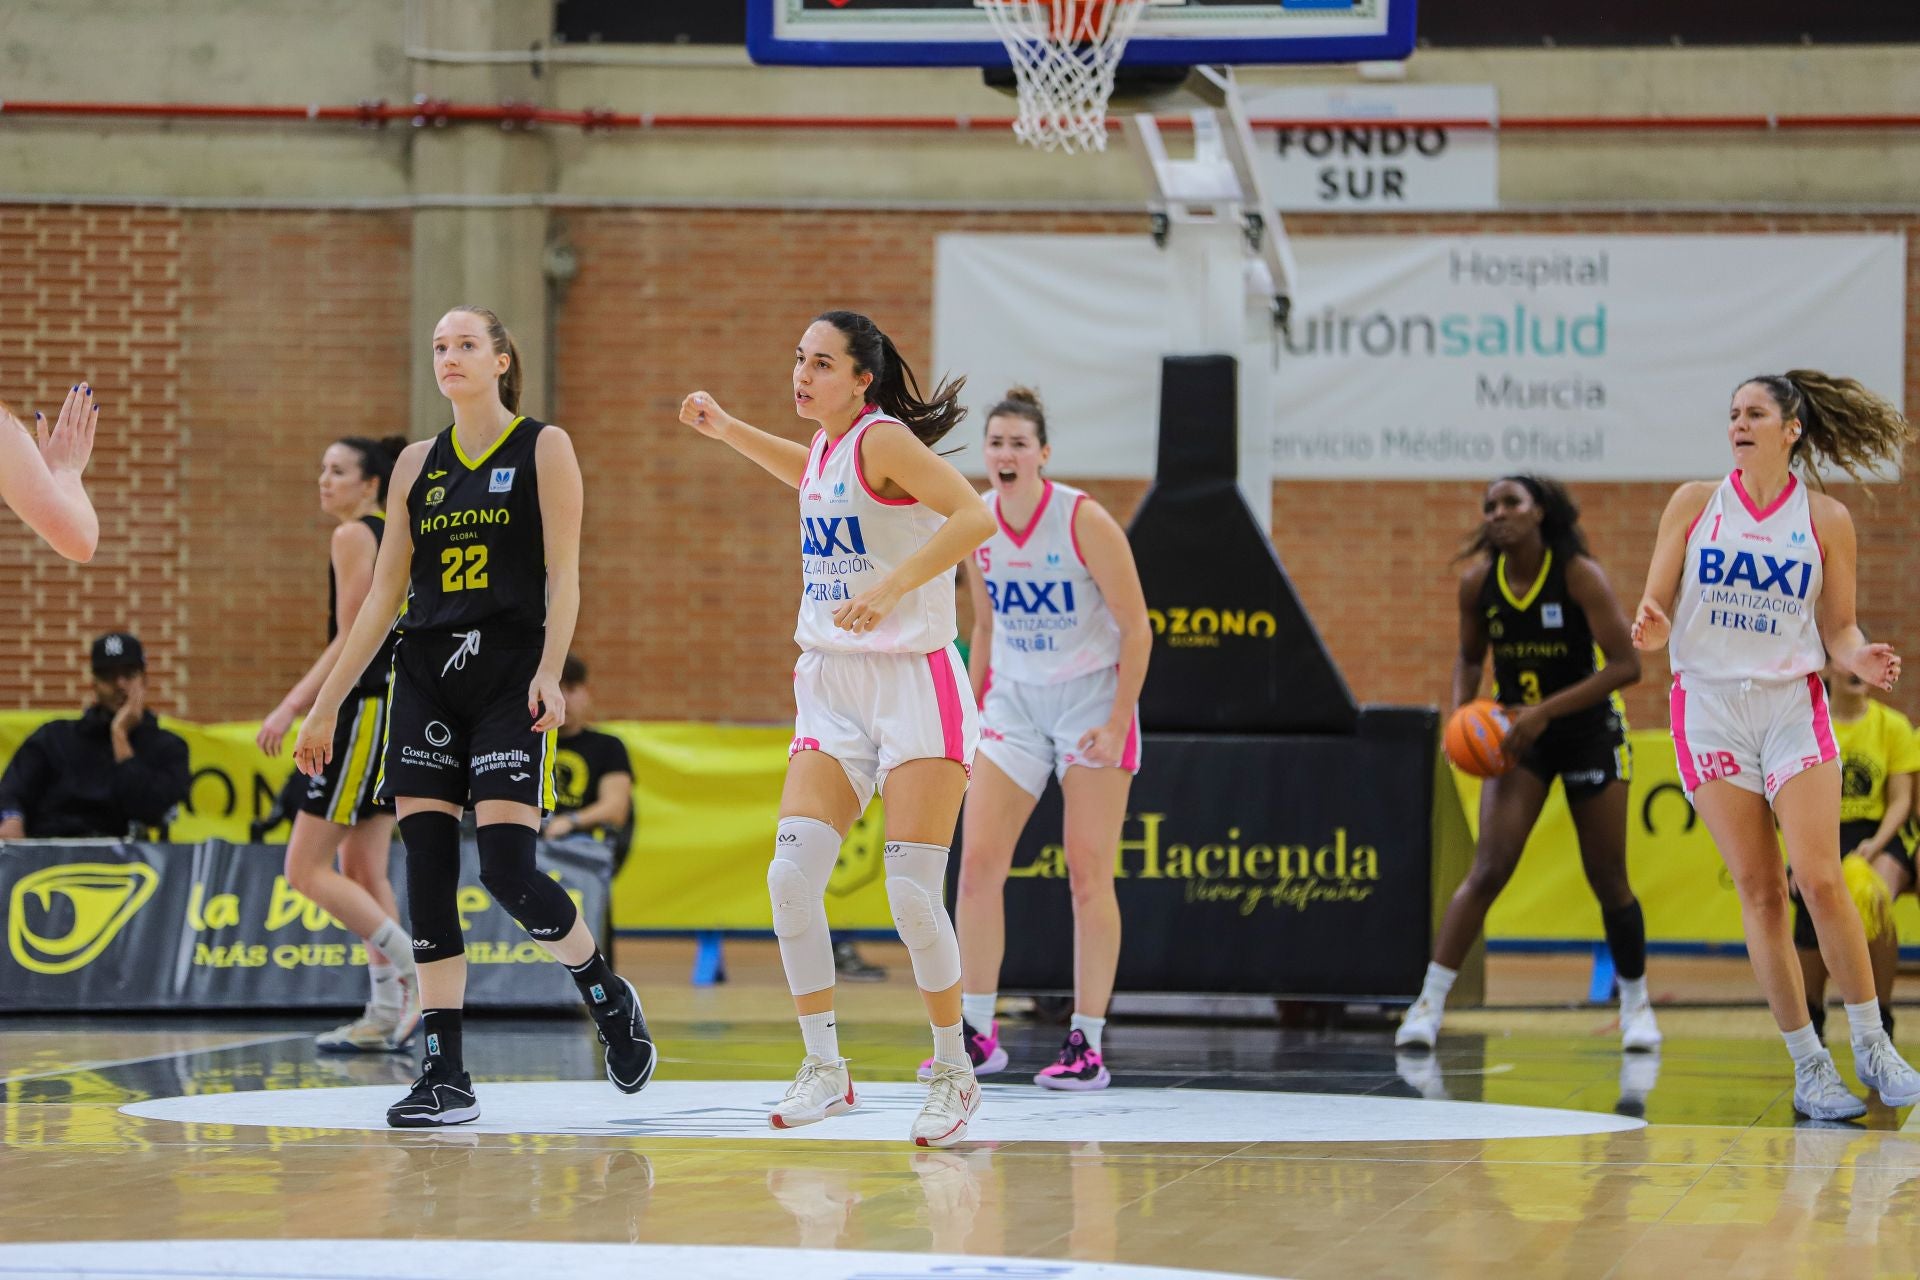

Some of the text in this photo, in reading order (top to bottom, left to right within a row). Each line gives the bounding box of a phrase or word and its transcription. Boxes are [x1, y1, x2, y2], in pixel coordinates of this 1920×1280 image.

[1277, 126, 1448, 157] FONDO
[1319, 168, 1404, 199] SUR
[1450, 249, 1609, 290] Hospital
[1285, 304, 1608, 357] uirónsalud
[1477, 374, 1606, 408] Murcia
[1273, 432, 1374, 462] ervicio
[1503, 425, 1604, 463] Oficial
[420, 508, 510, 535] HOZONO
[450, 532, 479, 542] GLOBAL
[802, 515, 867, 558] AXI
[1710, 514, 1723, 542] 1
[441, 544, 489, 593] 22
[973, 546, 991, 574] 5
[1698, 548, 1813, 600] BAXI
[1148, 607, 1276, 638] OZONO
[1519, 671, 1541, 706] 3
[402, 746, 430, 759] Costa
[470, 750, 530, 768] Alcantarilla
[1113, 812, 1381, 881] Hacienda
[187, 880, 241, 932] la
[194, 940, 269, 968] MÁS
[272, 943, 346, 969] QUE
